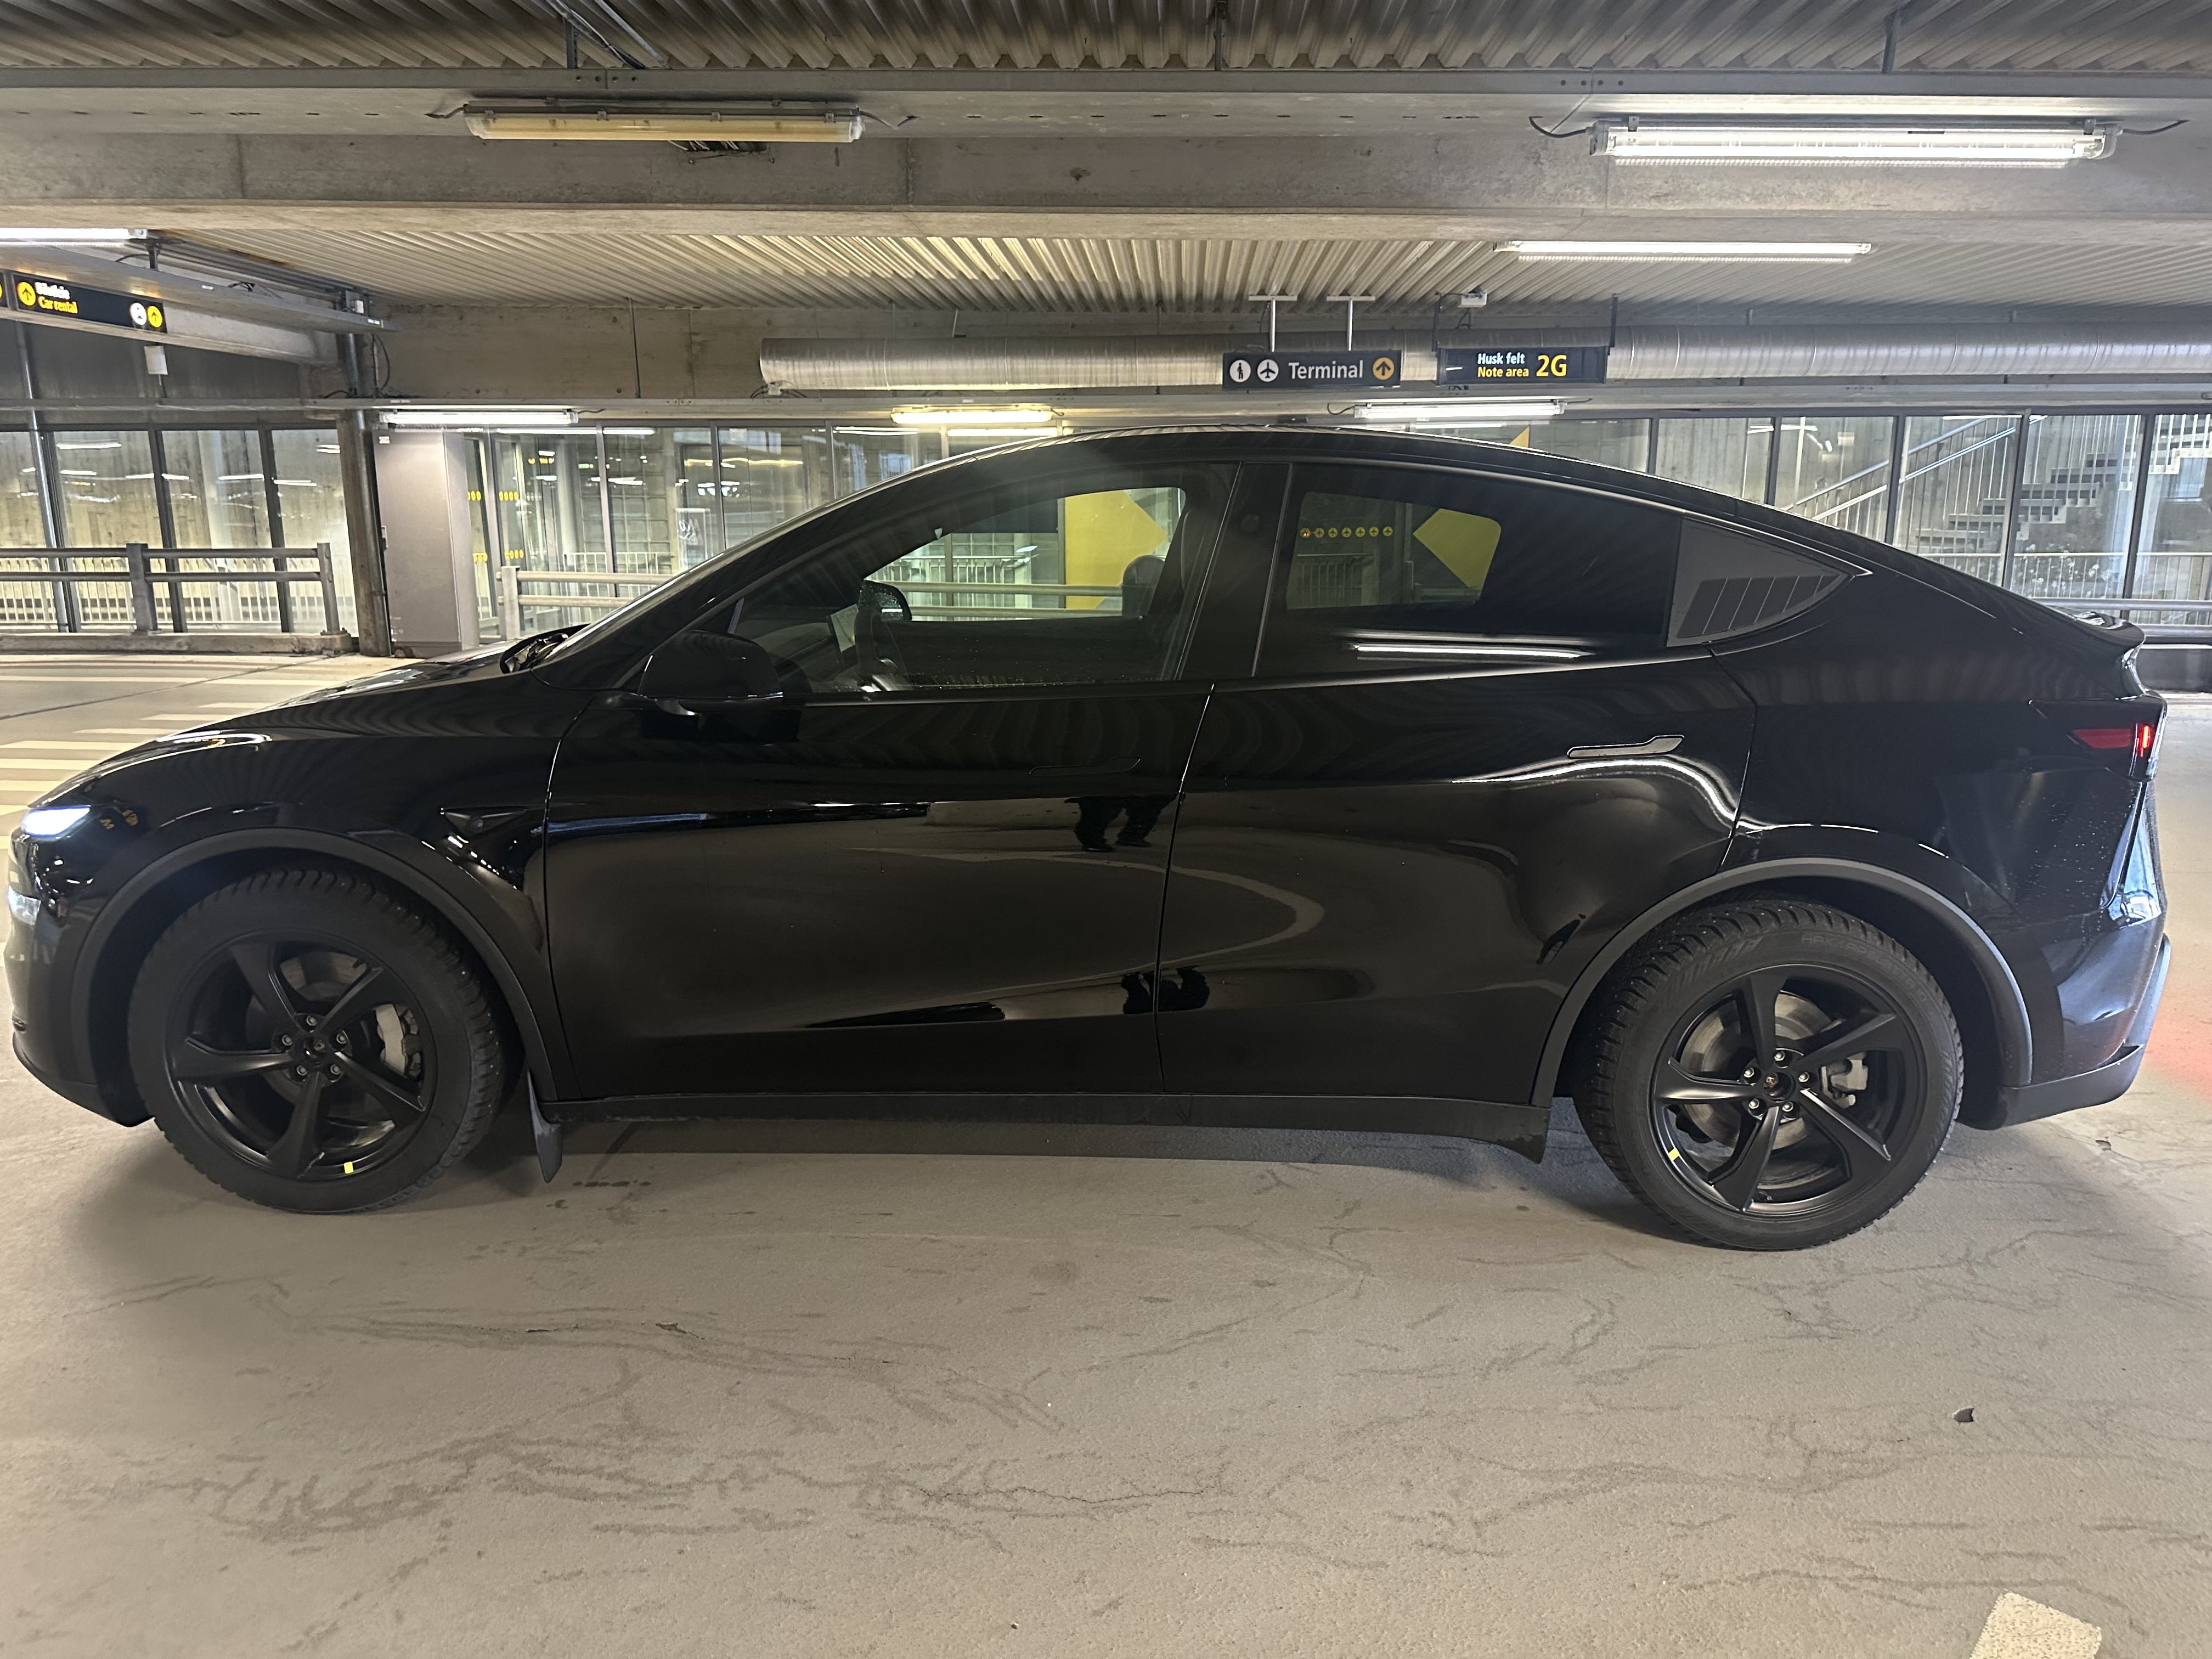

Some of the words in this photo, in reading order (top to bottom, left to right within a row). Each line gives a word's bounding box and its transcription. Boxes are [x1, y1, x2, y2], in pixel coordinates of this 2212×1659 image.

[38, 296, 53, 309] Car
[54, 301, 78, 314] rental
[1477, 353, 1503, 364] Husk
[1506, 352, 1525, 364] felt
[1536, 355, 1567, 377] 2G
[1288, 360, 1363, 379] Terminal
[1477, 366, 1503, 377] Note
[1505, 368, 1530, 377] area
